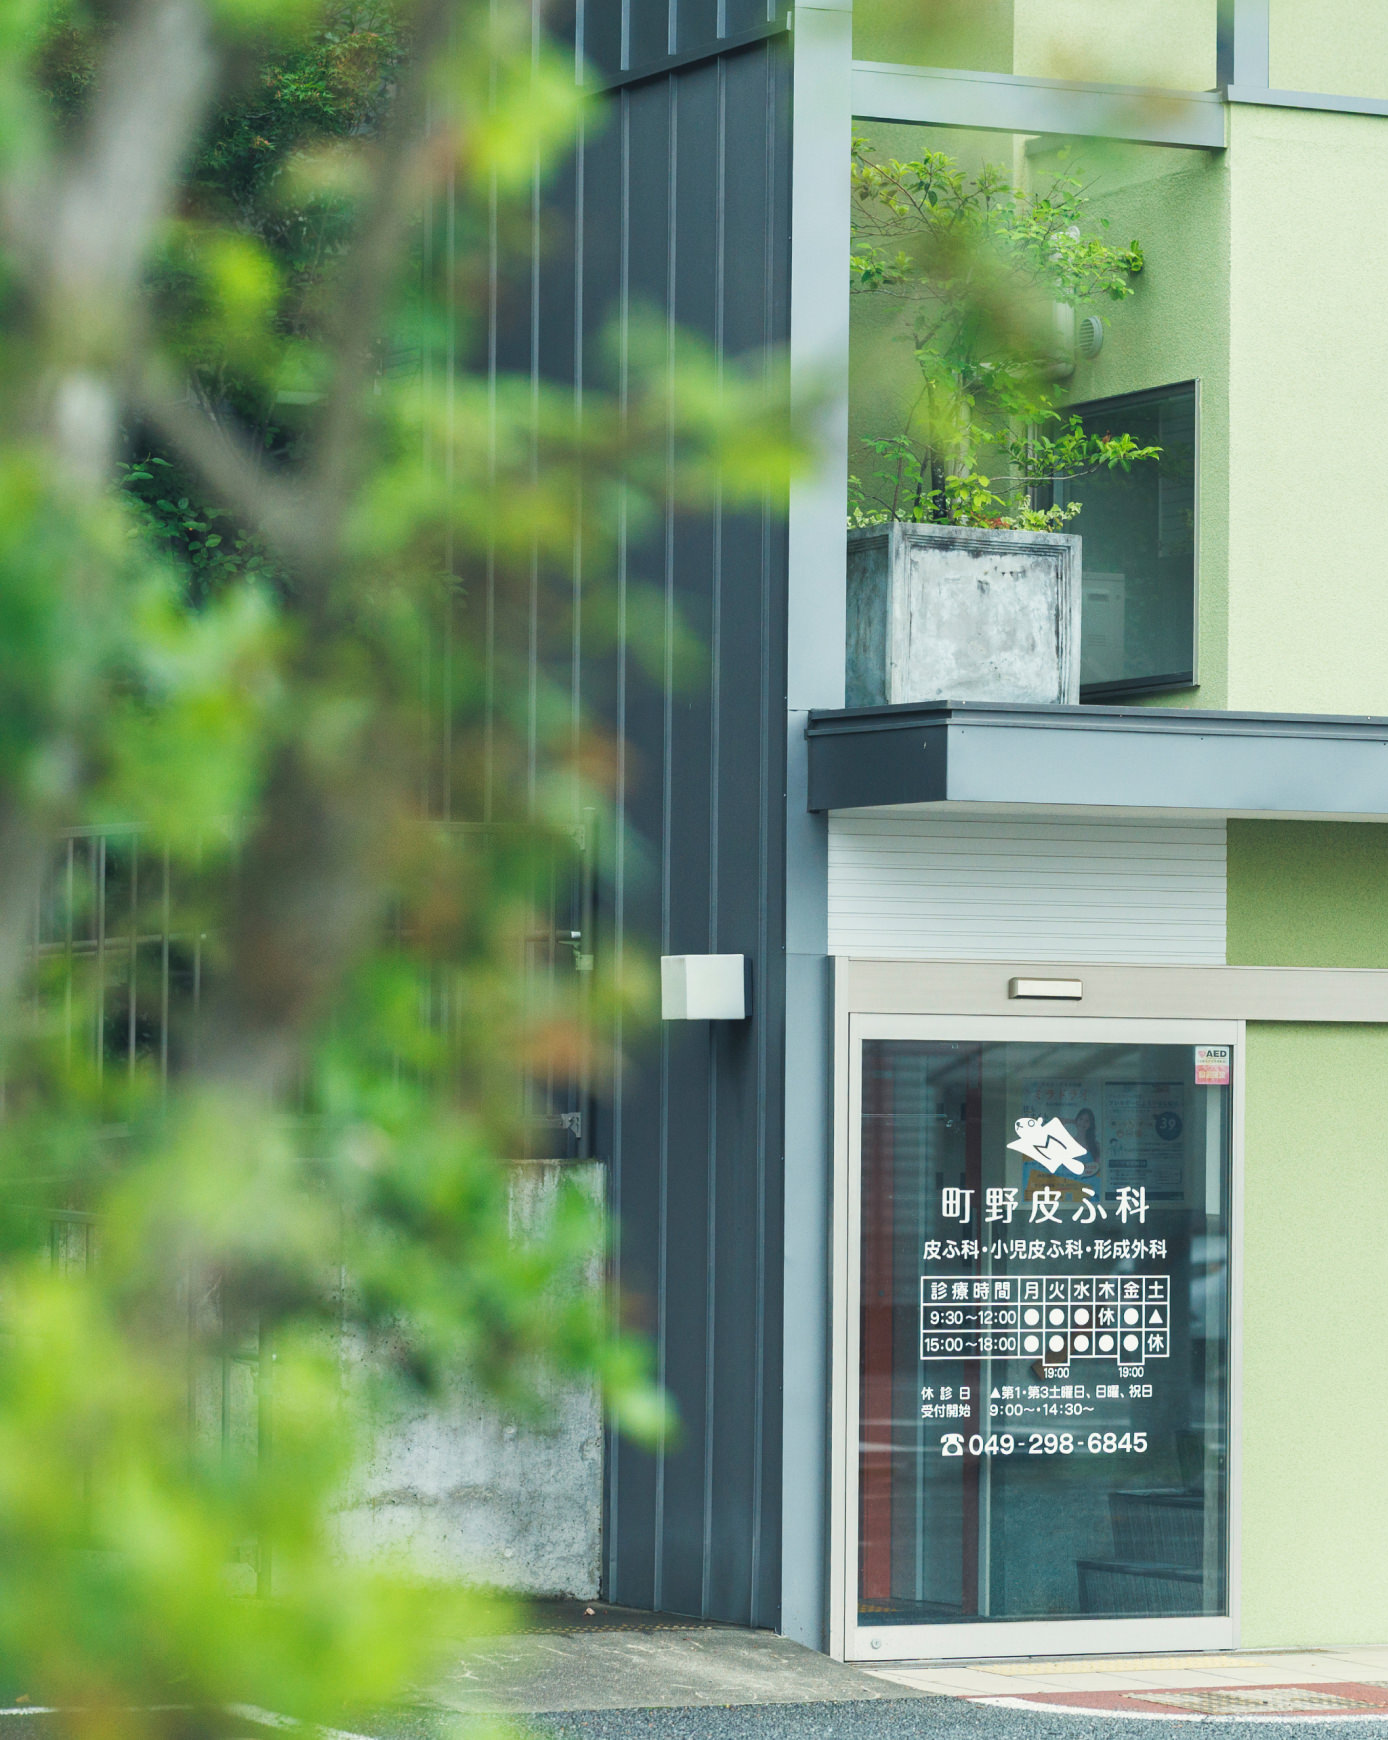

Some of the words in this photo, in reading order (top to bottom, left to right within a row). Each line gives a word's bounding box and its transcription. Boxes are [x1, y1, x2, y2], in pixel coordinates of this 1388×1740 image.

[1205, 1049, 1228, 1058] AED
[1159, 1116, 1176, 1130] 39
[943, 1186, 1149, 1223] 町野皮ふ科
[924, 1240, 1166, 1259] 皮ふ科・小児皮ふ科・形成外科
[931, 1282, 1010, 1300] 診療時間
[1025, 1282, 1038, 1299] 月
[1049, 1282, 1064, 1299] 火
[1074, 1282, 1089, 1299] 水
[1099, 1282, 1114, 1299] 木
[1124, 1282, 1139, 1298] 金
[1148, 1281, 1164, 1298] 土
[1099, 1308, 1114, 1325] 休
[1148, 1334, 1164, 1351] 休
[1044, 1368, 1069, 1378] 19:00
[1119, 1367, 1144, 1377] 19:00
[921, 1404, 970, 1418] 受付開始
[969, 1433, 1147, 1455] 049-298-6845
